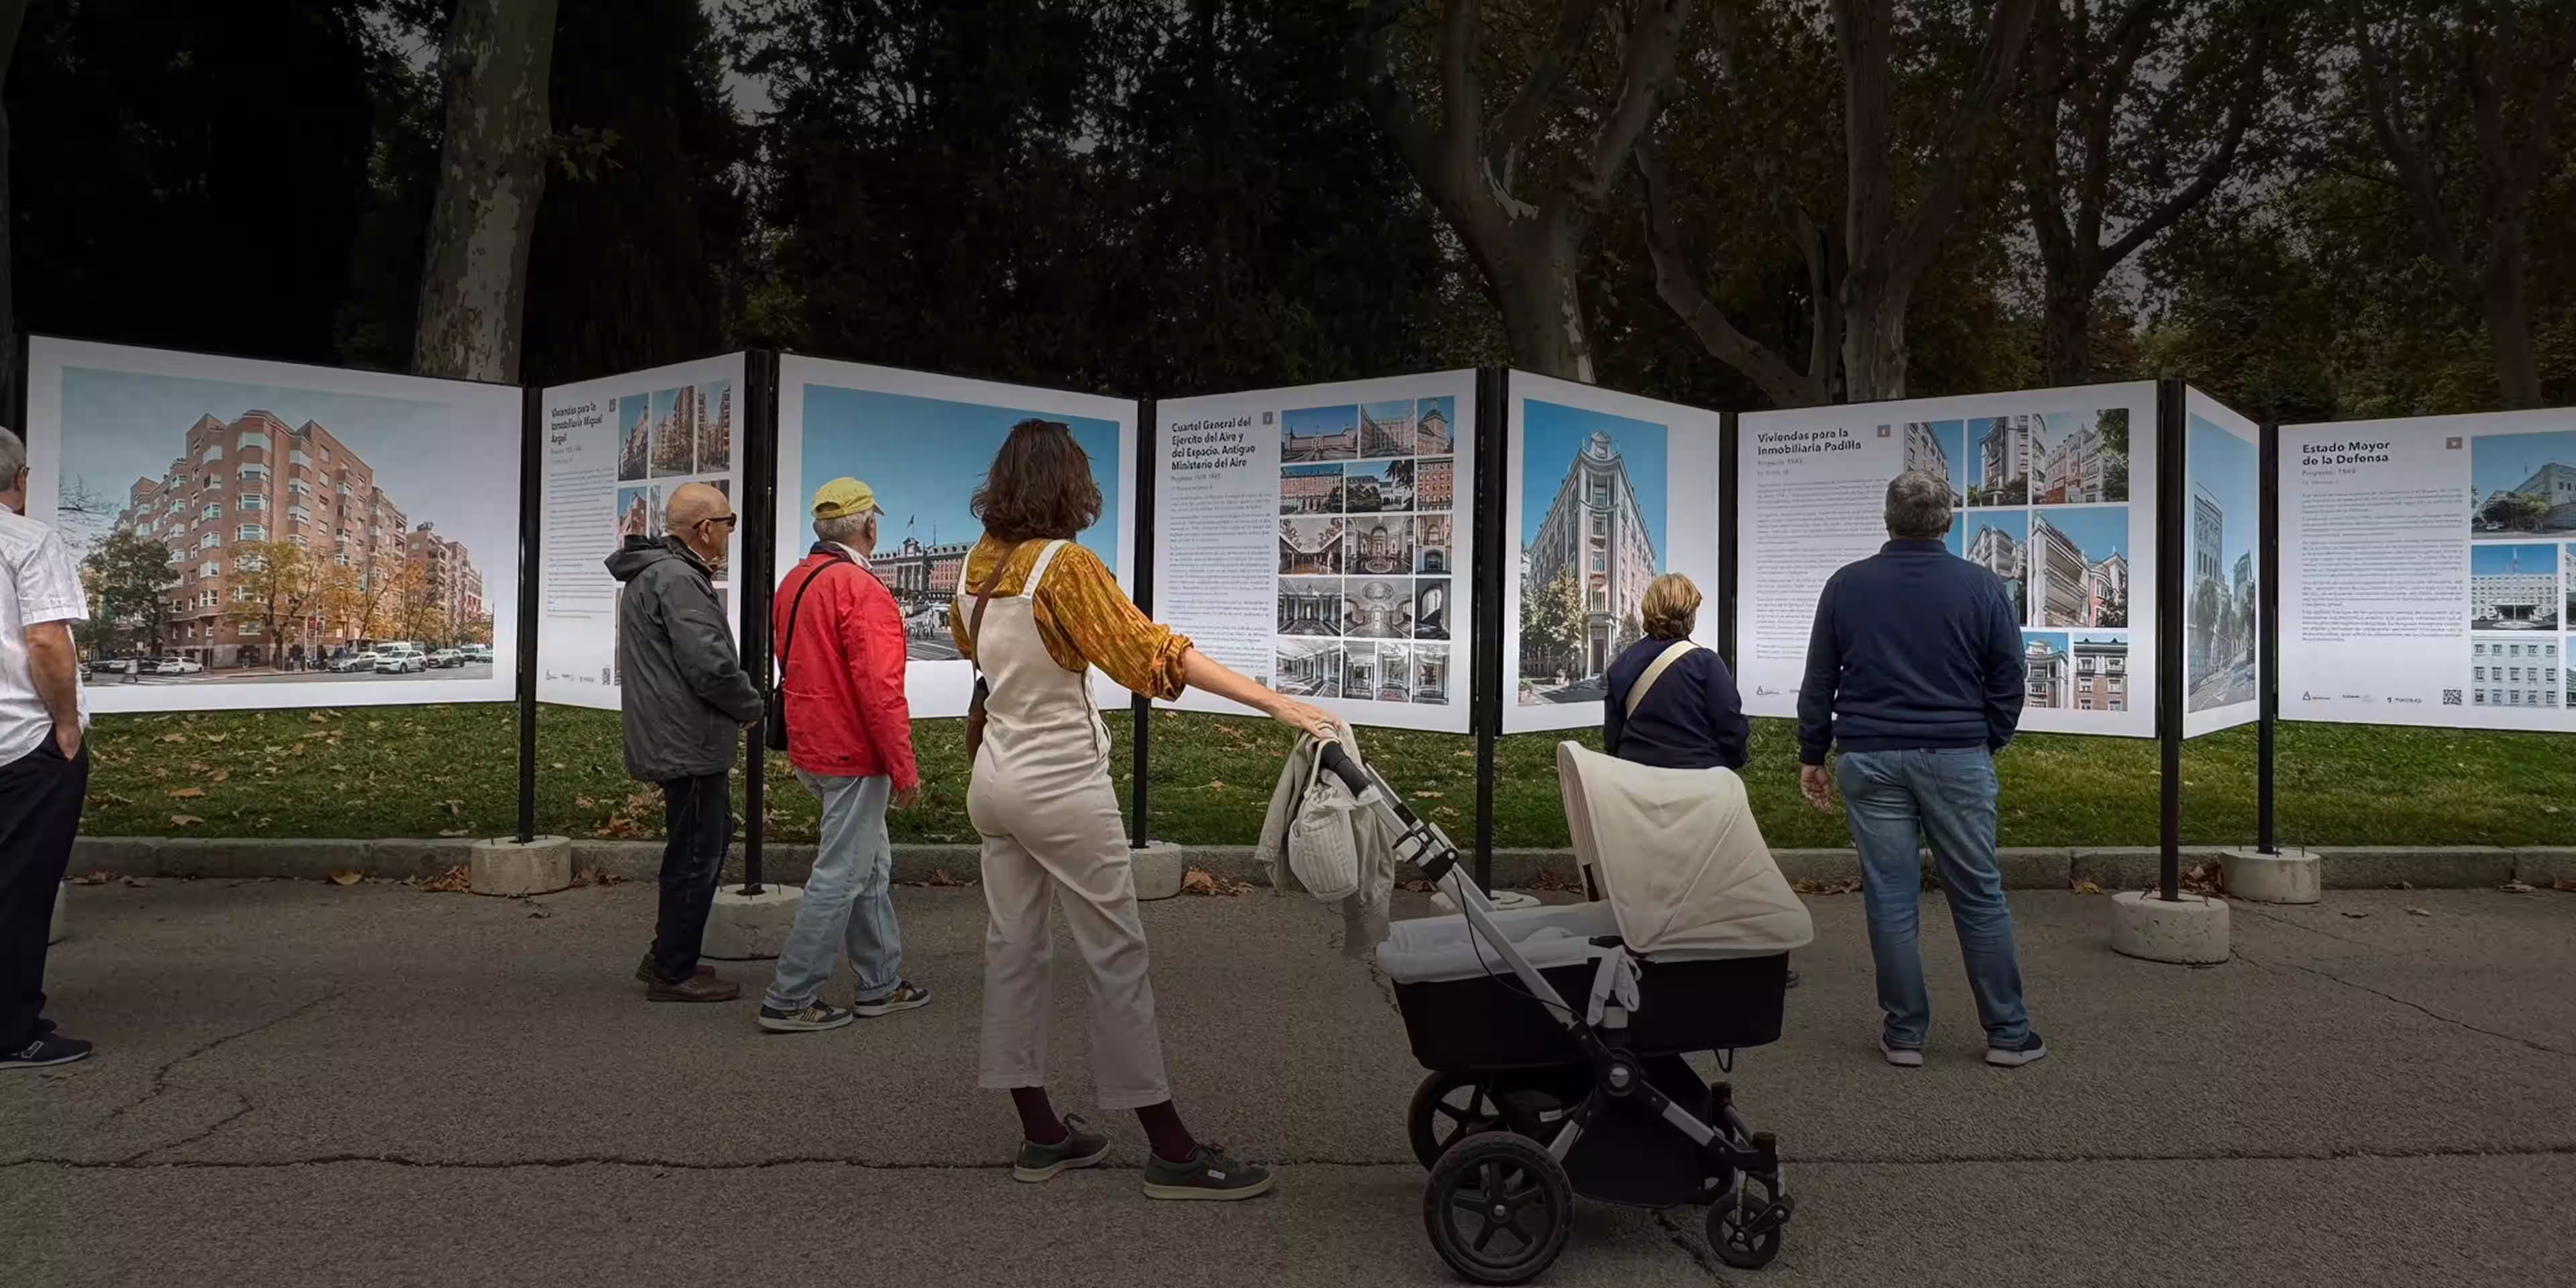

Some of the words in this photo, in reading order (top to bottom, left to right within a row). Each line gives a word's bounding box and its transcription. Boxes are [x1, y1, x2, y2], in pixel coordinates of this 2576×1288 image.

[1172, 421, 1201, 432] Cuartel
[1203, 418, 1235, 430] General
[1237, 416, 1251, 427] del
[1204, 432, 1217, 443] del
[1238, 432, 1244, 443] y
[1758, 431, 1809, 443] Viviendas
[1812, 431, 1836, 441] para
[1839, 427, 1849, 437] la
[1758, 443, 1821, 455] Inmobiliaria
[1825, 440, 1861, 451] Padilla
[2303, 442, 2345, 453] Estado
[2348, 441, 2391, 453] Mayor
[1172, 459, 1213, 470] Ministerio
[1214, 458, 1228, 468] del
[2322, 456, 2332, 465] la
[2337, 453, 2389, 464] Defensa
